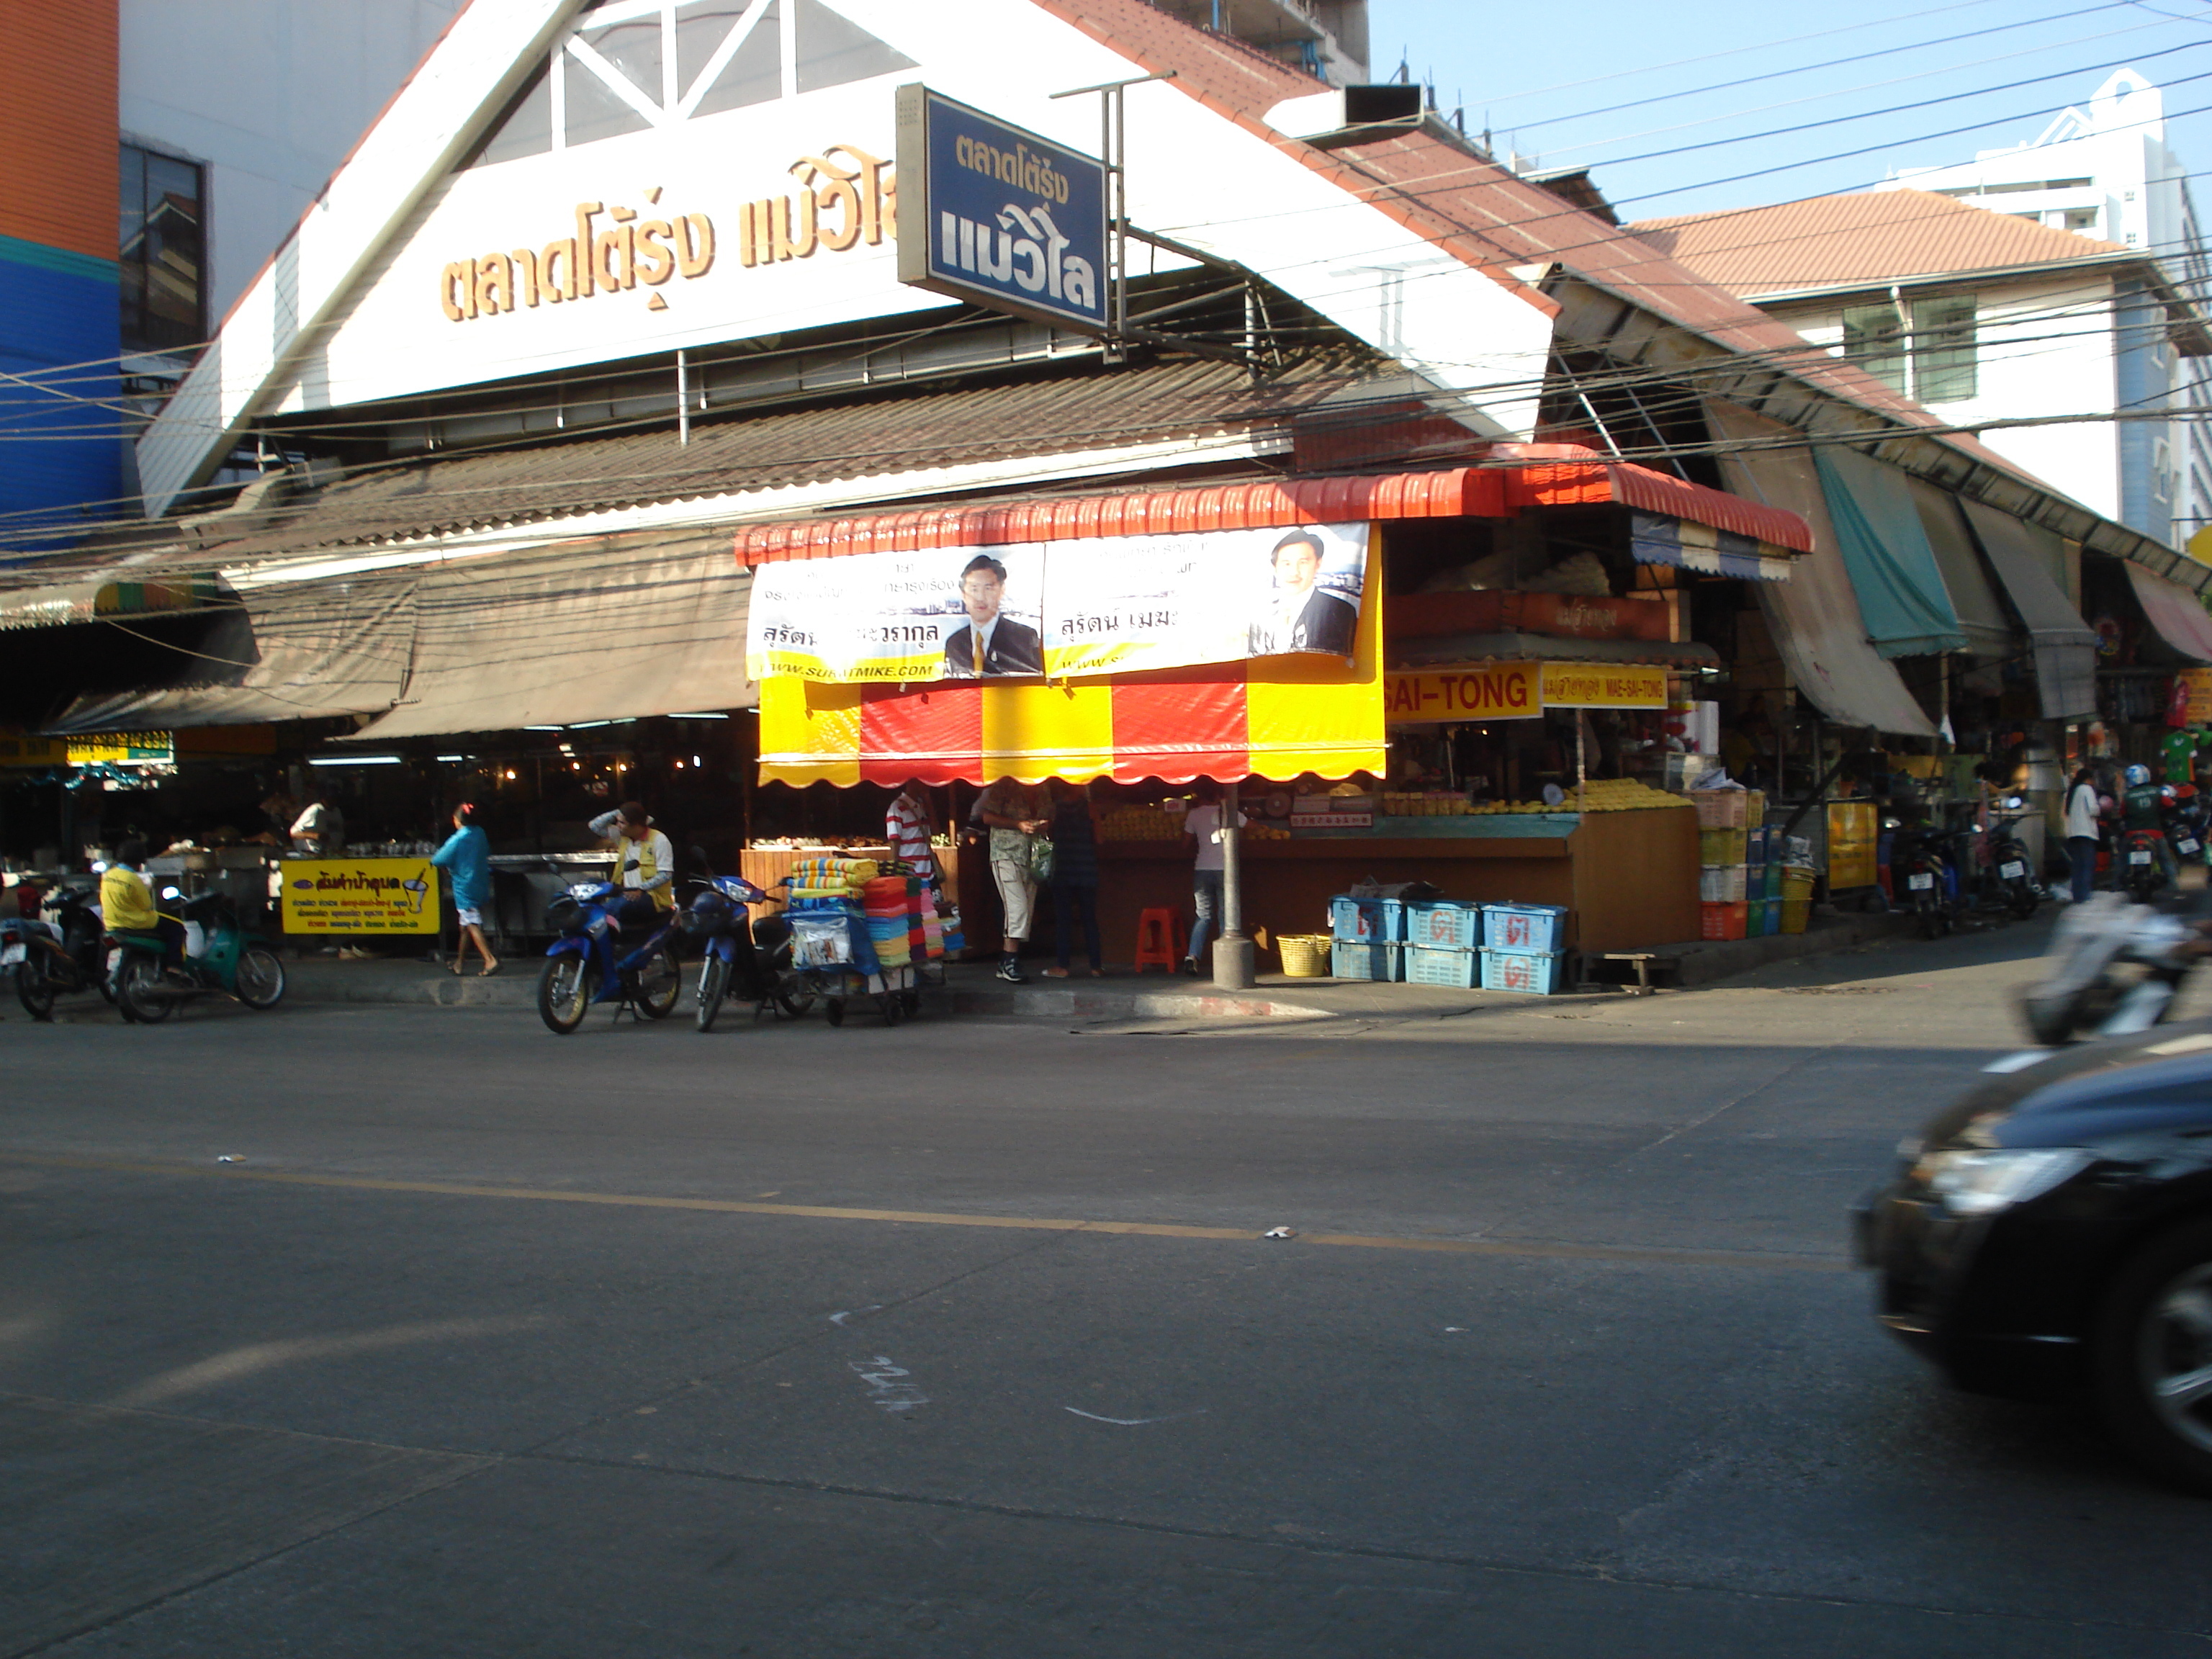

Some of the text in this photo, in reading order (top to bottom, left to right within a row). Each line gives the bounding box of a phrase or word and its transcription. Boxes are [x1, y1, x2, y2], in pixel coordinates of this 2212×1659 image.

[956, 135, 1069, 212] ตลาดโต้รุ่ง
[441, 186, 715, 322] ตลาดโต้รุ่ง
[941, 203, 1096, 310] แม่วิไล
[760, 663, 932, 678] WW.SURTMIKE.COM
[1606, 679, 1663, 698] MAE-SAI-TONG
